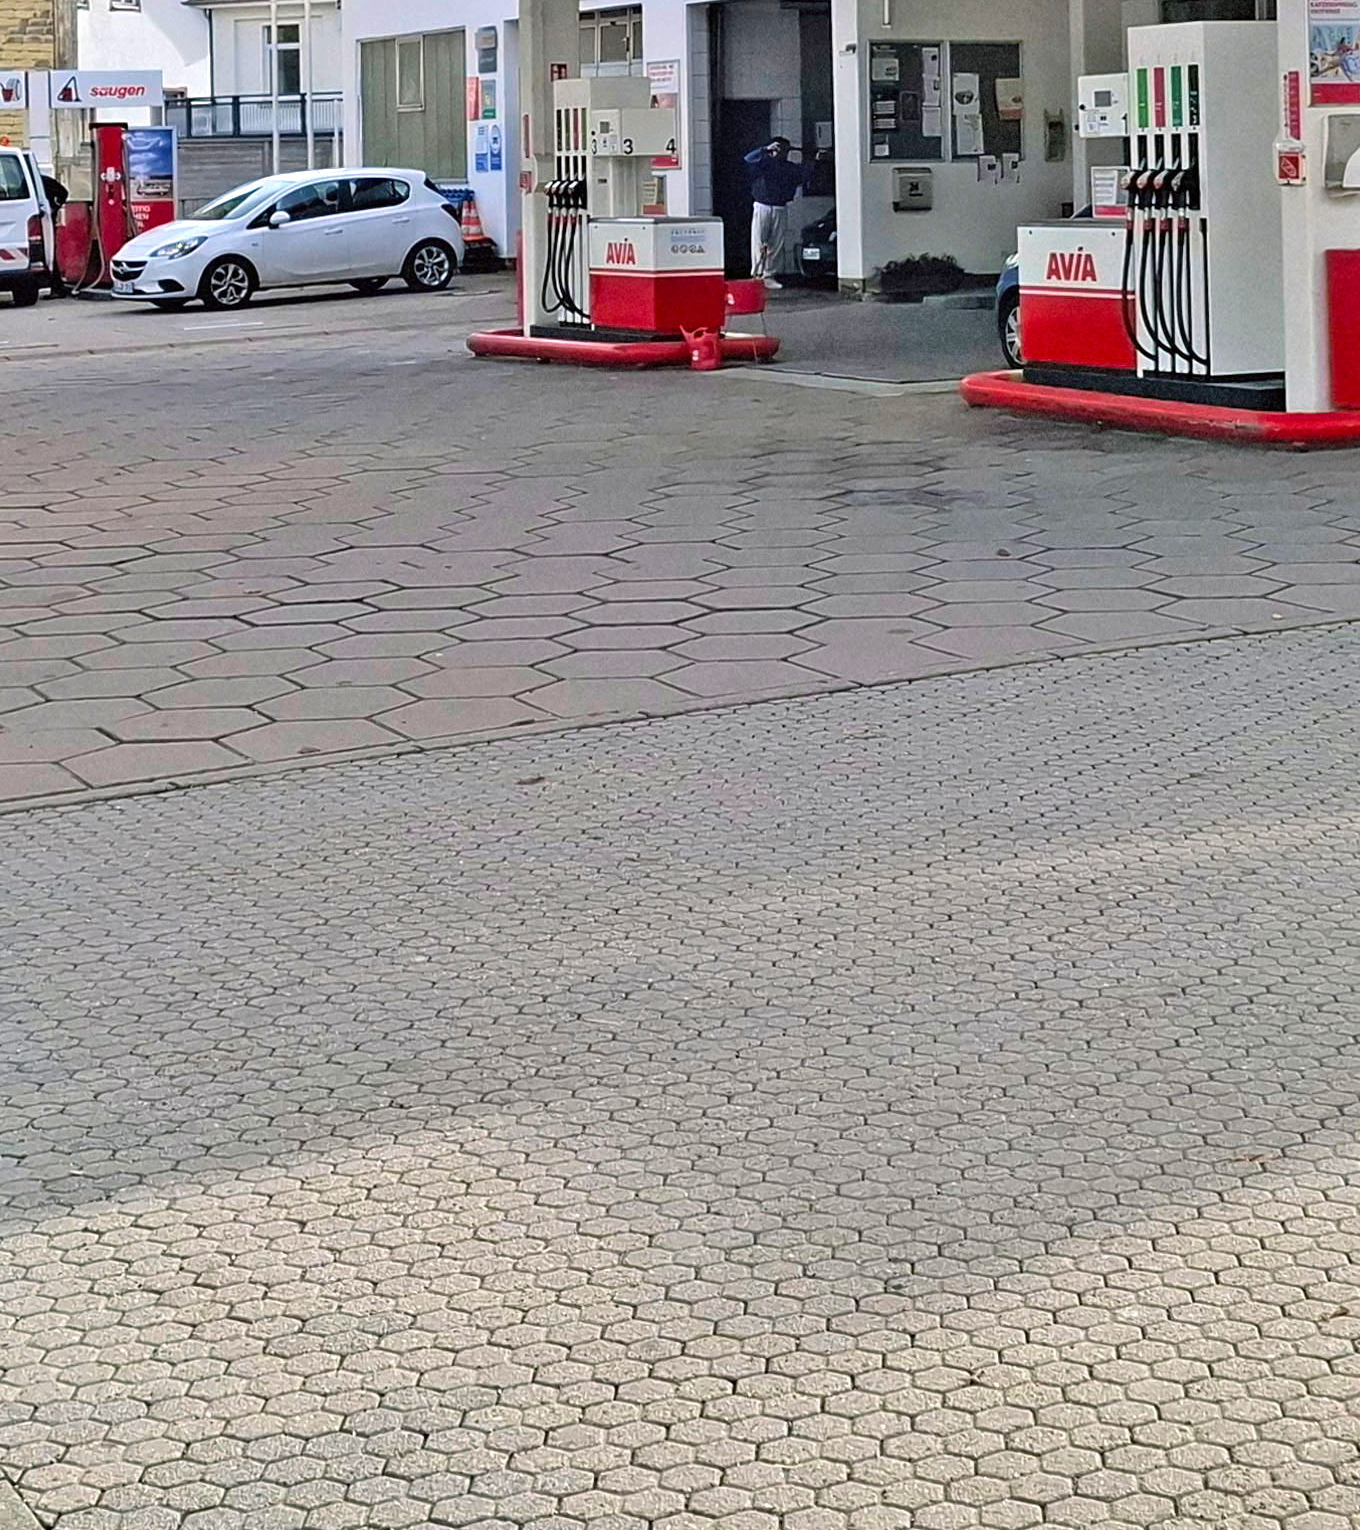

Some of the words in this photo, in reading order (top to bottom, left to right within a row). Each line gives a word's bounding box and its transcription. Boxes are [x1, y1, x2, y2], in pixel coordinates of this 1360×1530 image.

[89, 85, 146, 98] saugen
[623, 138, 634, 155] 3
[665, 138, 677, 154] 4
[605, 237, 636, 265] AVIA
[1046, 246, 1097, 282] AVIA
